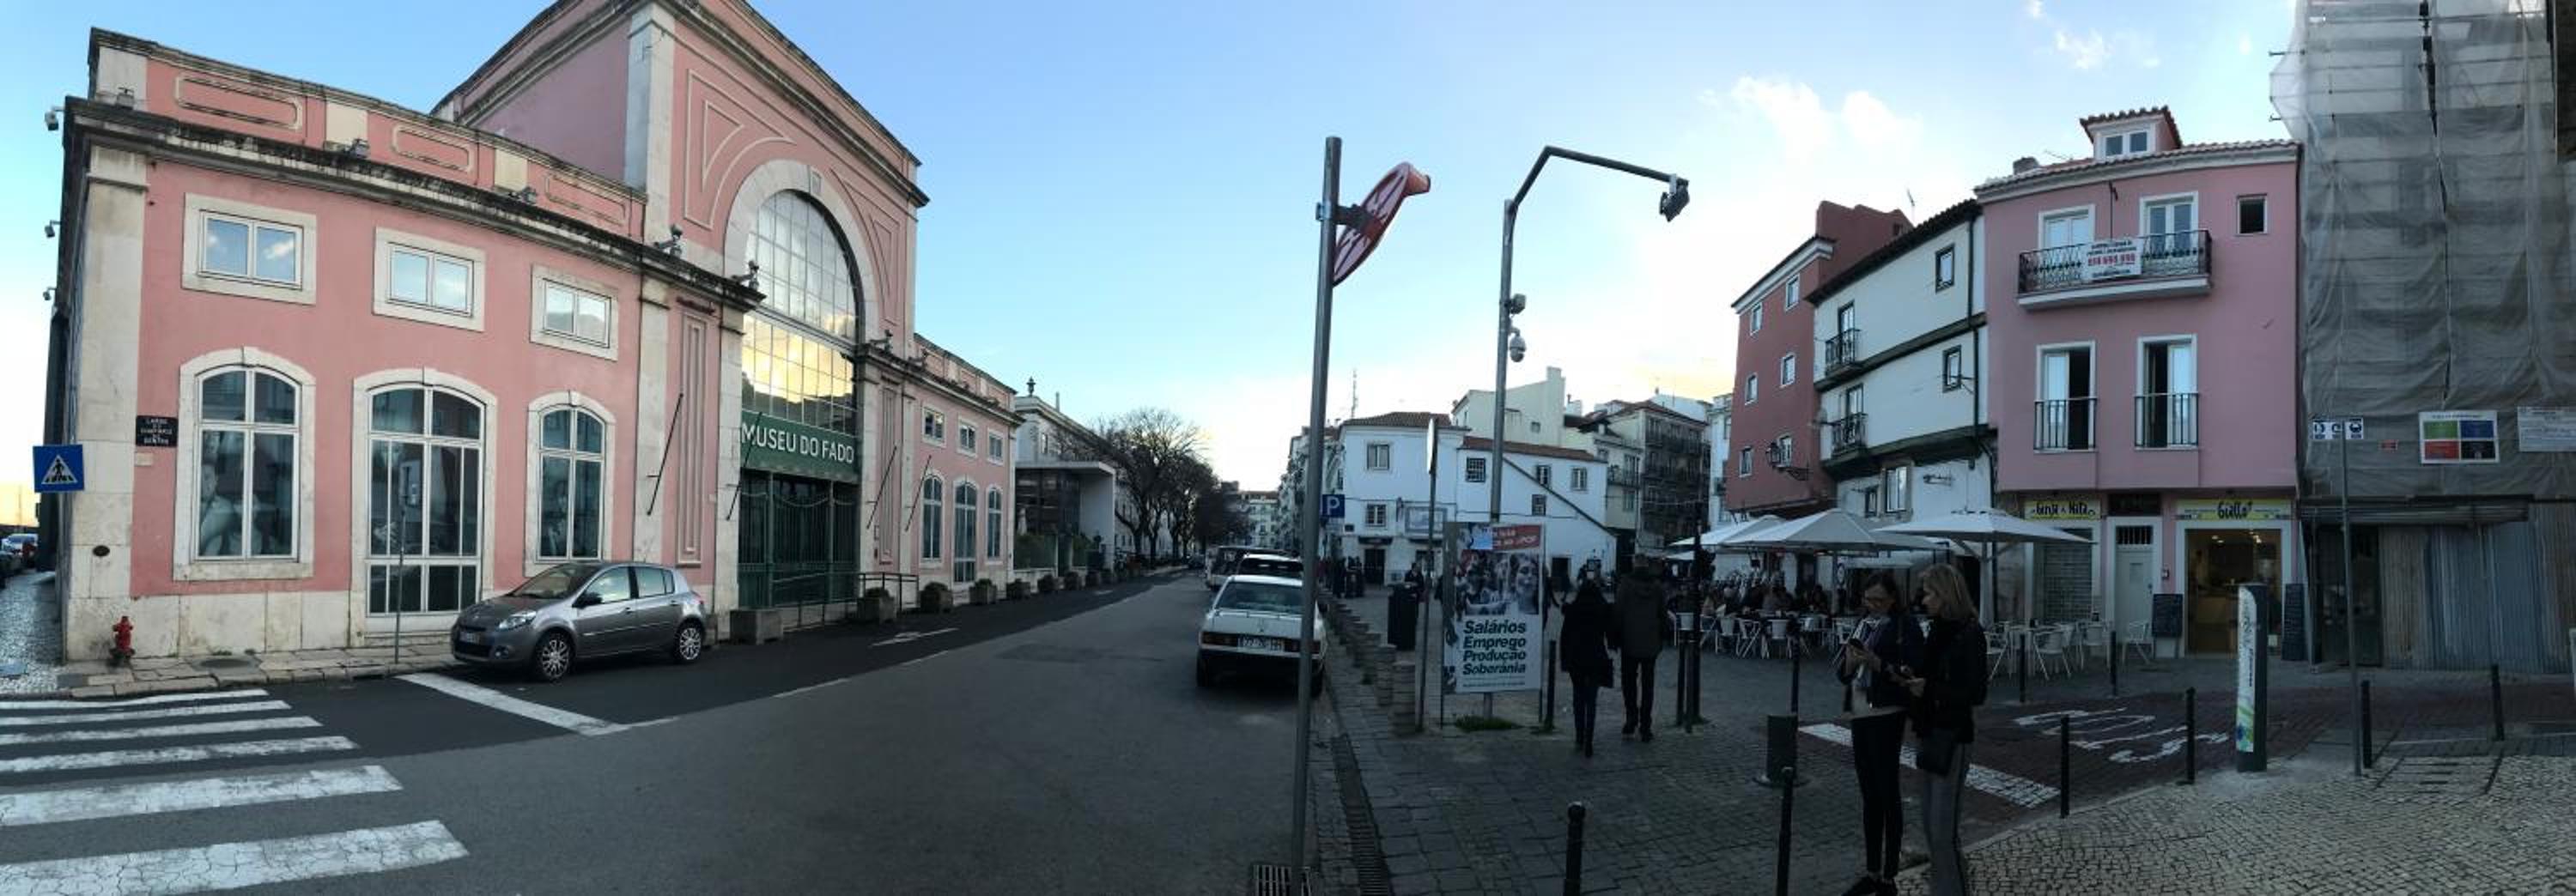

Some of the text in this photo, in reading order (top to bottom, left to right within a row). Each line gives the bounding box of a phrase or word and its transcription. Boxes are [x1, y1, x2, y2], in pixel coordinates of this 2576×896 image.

[741, 422, 854, 463] MUSEU DO FADO
[1326, 496, 1340, 515] P
[1463, 619, 1526, 633] Salários
[1463, 636, 1526, 651] Emprego
[1463, 650, 1526, 663] Produção
